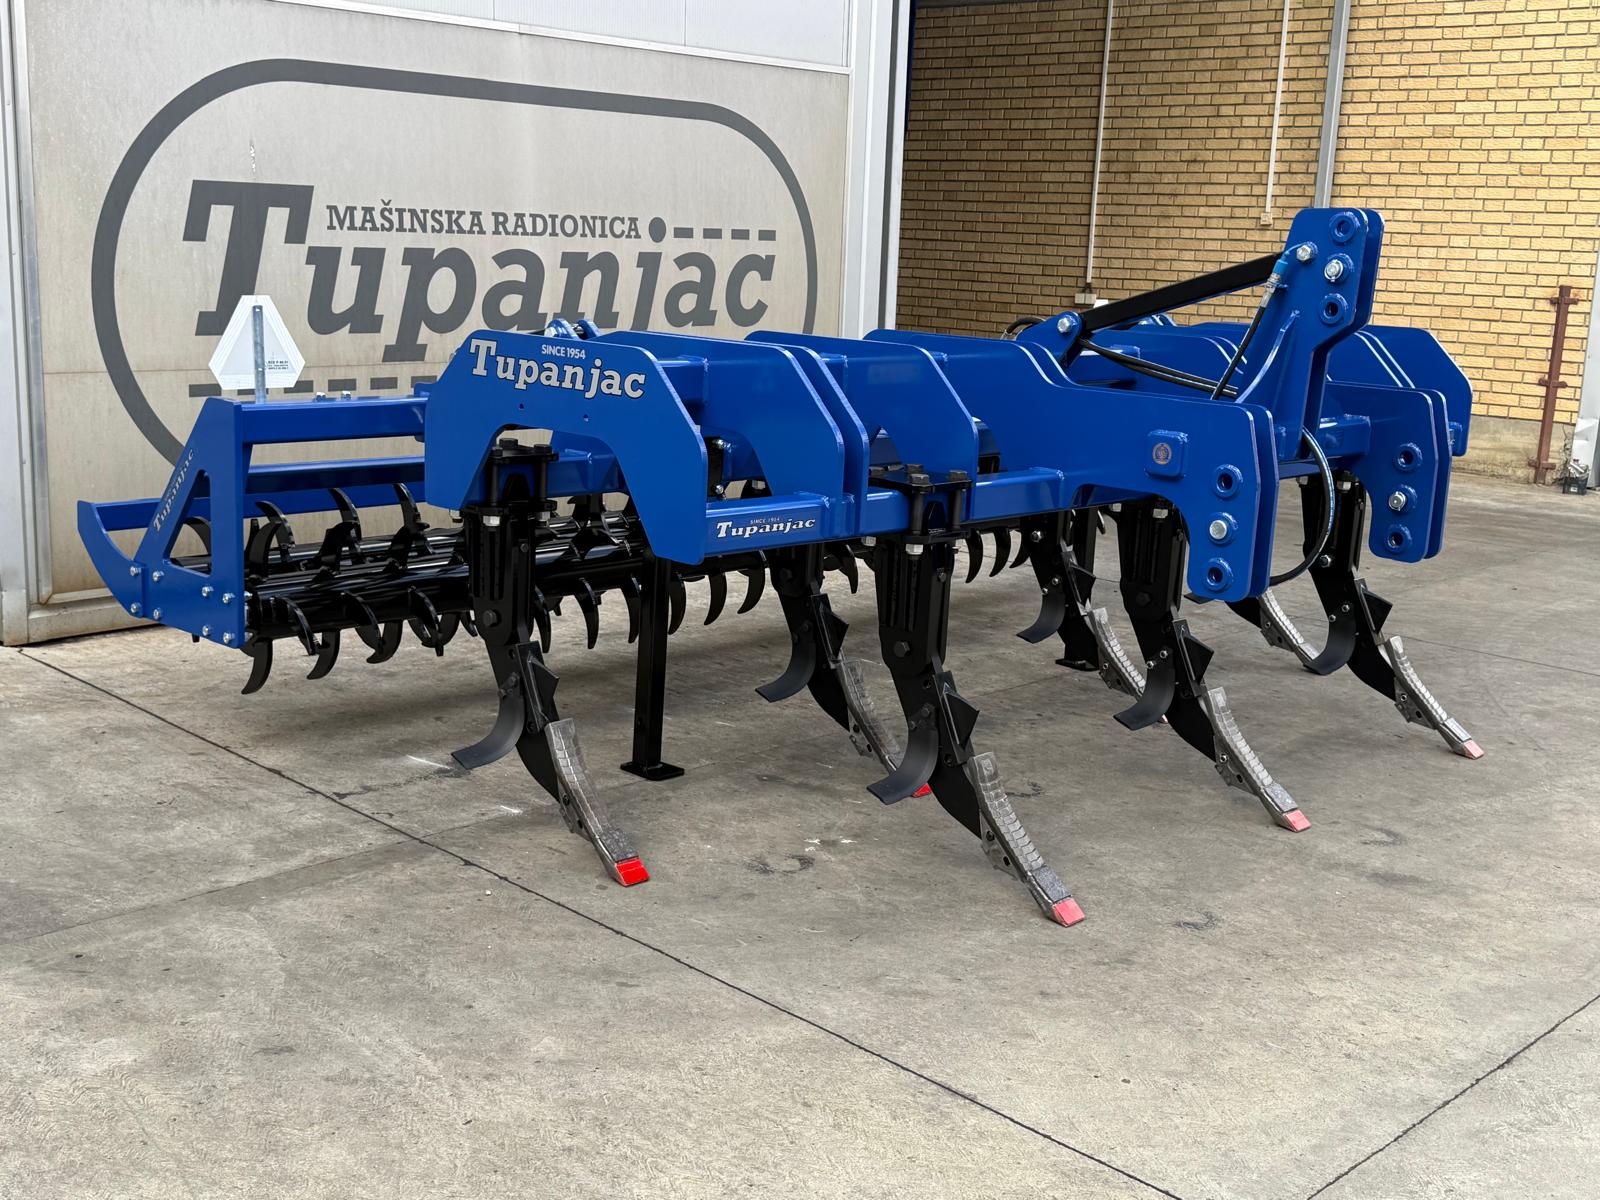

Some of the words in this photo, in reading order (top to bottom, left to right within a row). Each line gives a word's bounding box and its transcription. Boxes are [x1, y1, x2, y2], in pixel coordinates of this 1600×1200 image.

[326, 199, 486, 235] MAŠINSKA
[491, 211, 641, 239] RADIONICA
[182, 179, 777, 363] Tupanjac
[469, 338, 646, 399] Tupanjac
[541, 344, 566, 357] SINCE
[567, 347, 586, 360] 1954
[716, 518, 816, 538] Tupanjac
